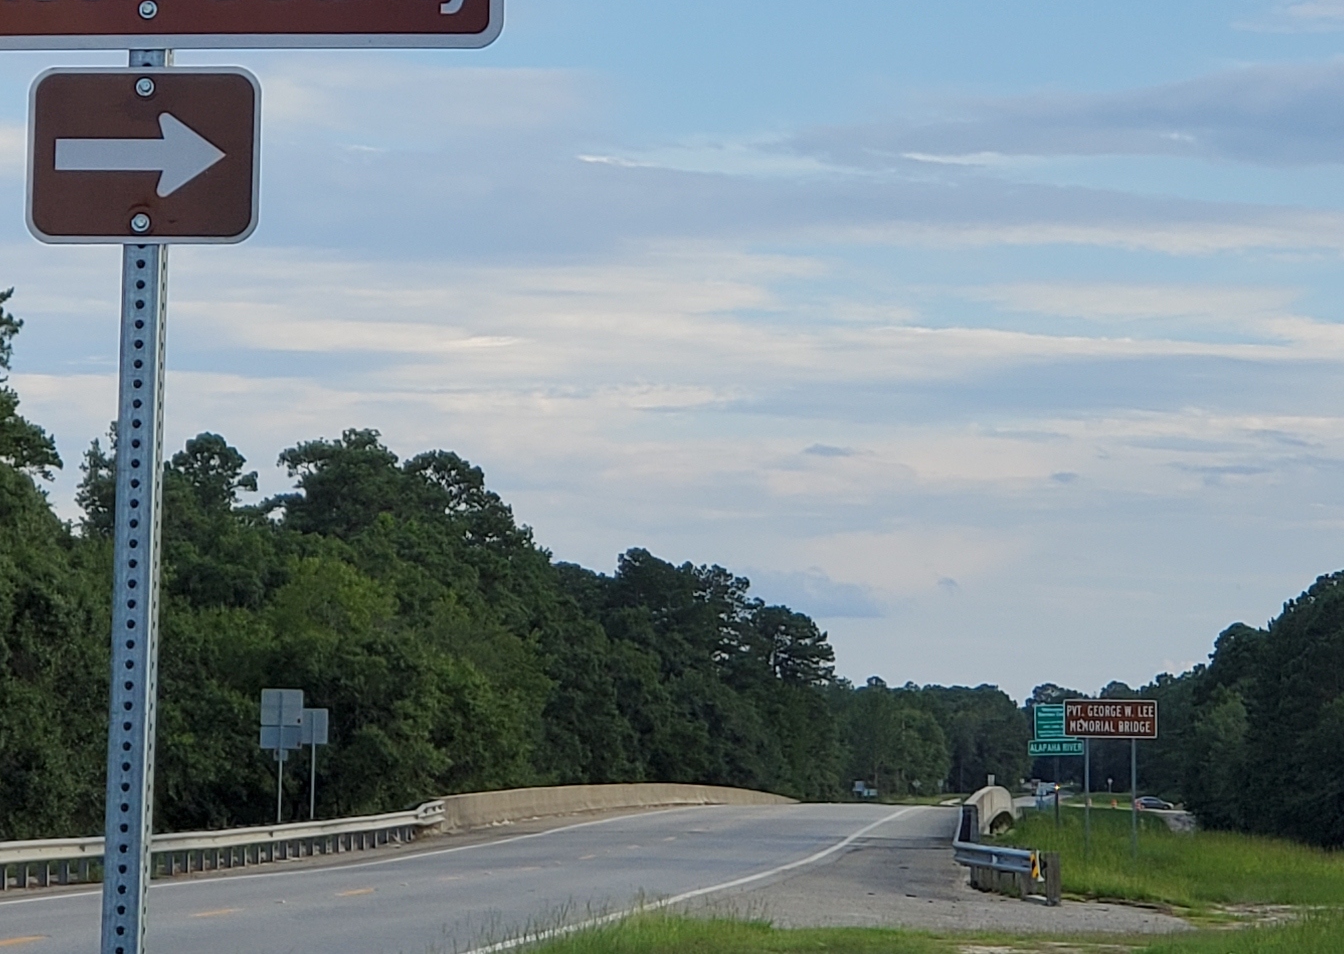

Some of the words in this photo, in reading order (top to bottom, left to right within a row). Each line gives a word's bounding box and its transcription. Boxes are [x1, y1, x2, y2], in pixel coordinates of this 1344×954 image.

[1066, 705, 1085, 717] PVT.
[1087, 705, 1122, 717] GEORGE
[1124, 706, 1135, 717] W.
[1138, 706, 1154, 718] LEE
[1069, 720, 1116, 732] MEMORIAL
[1118, 721, 1151, 733] BRIDGE
[1029, 743, 1061, 752] ALAPAHA
[1062, 743, 1083, 751] RIVER
